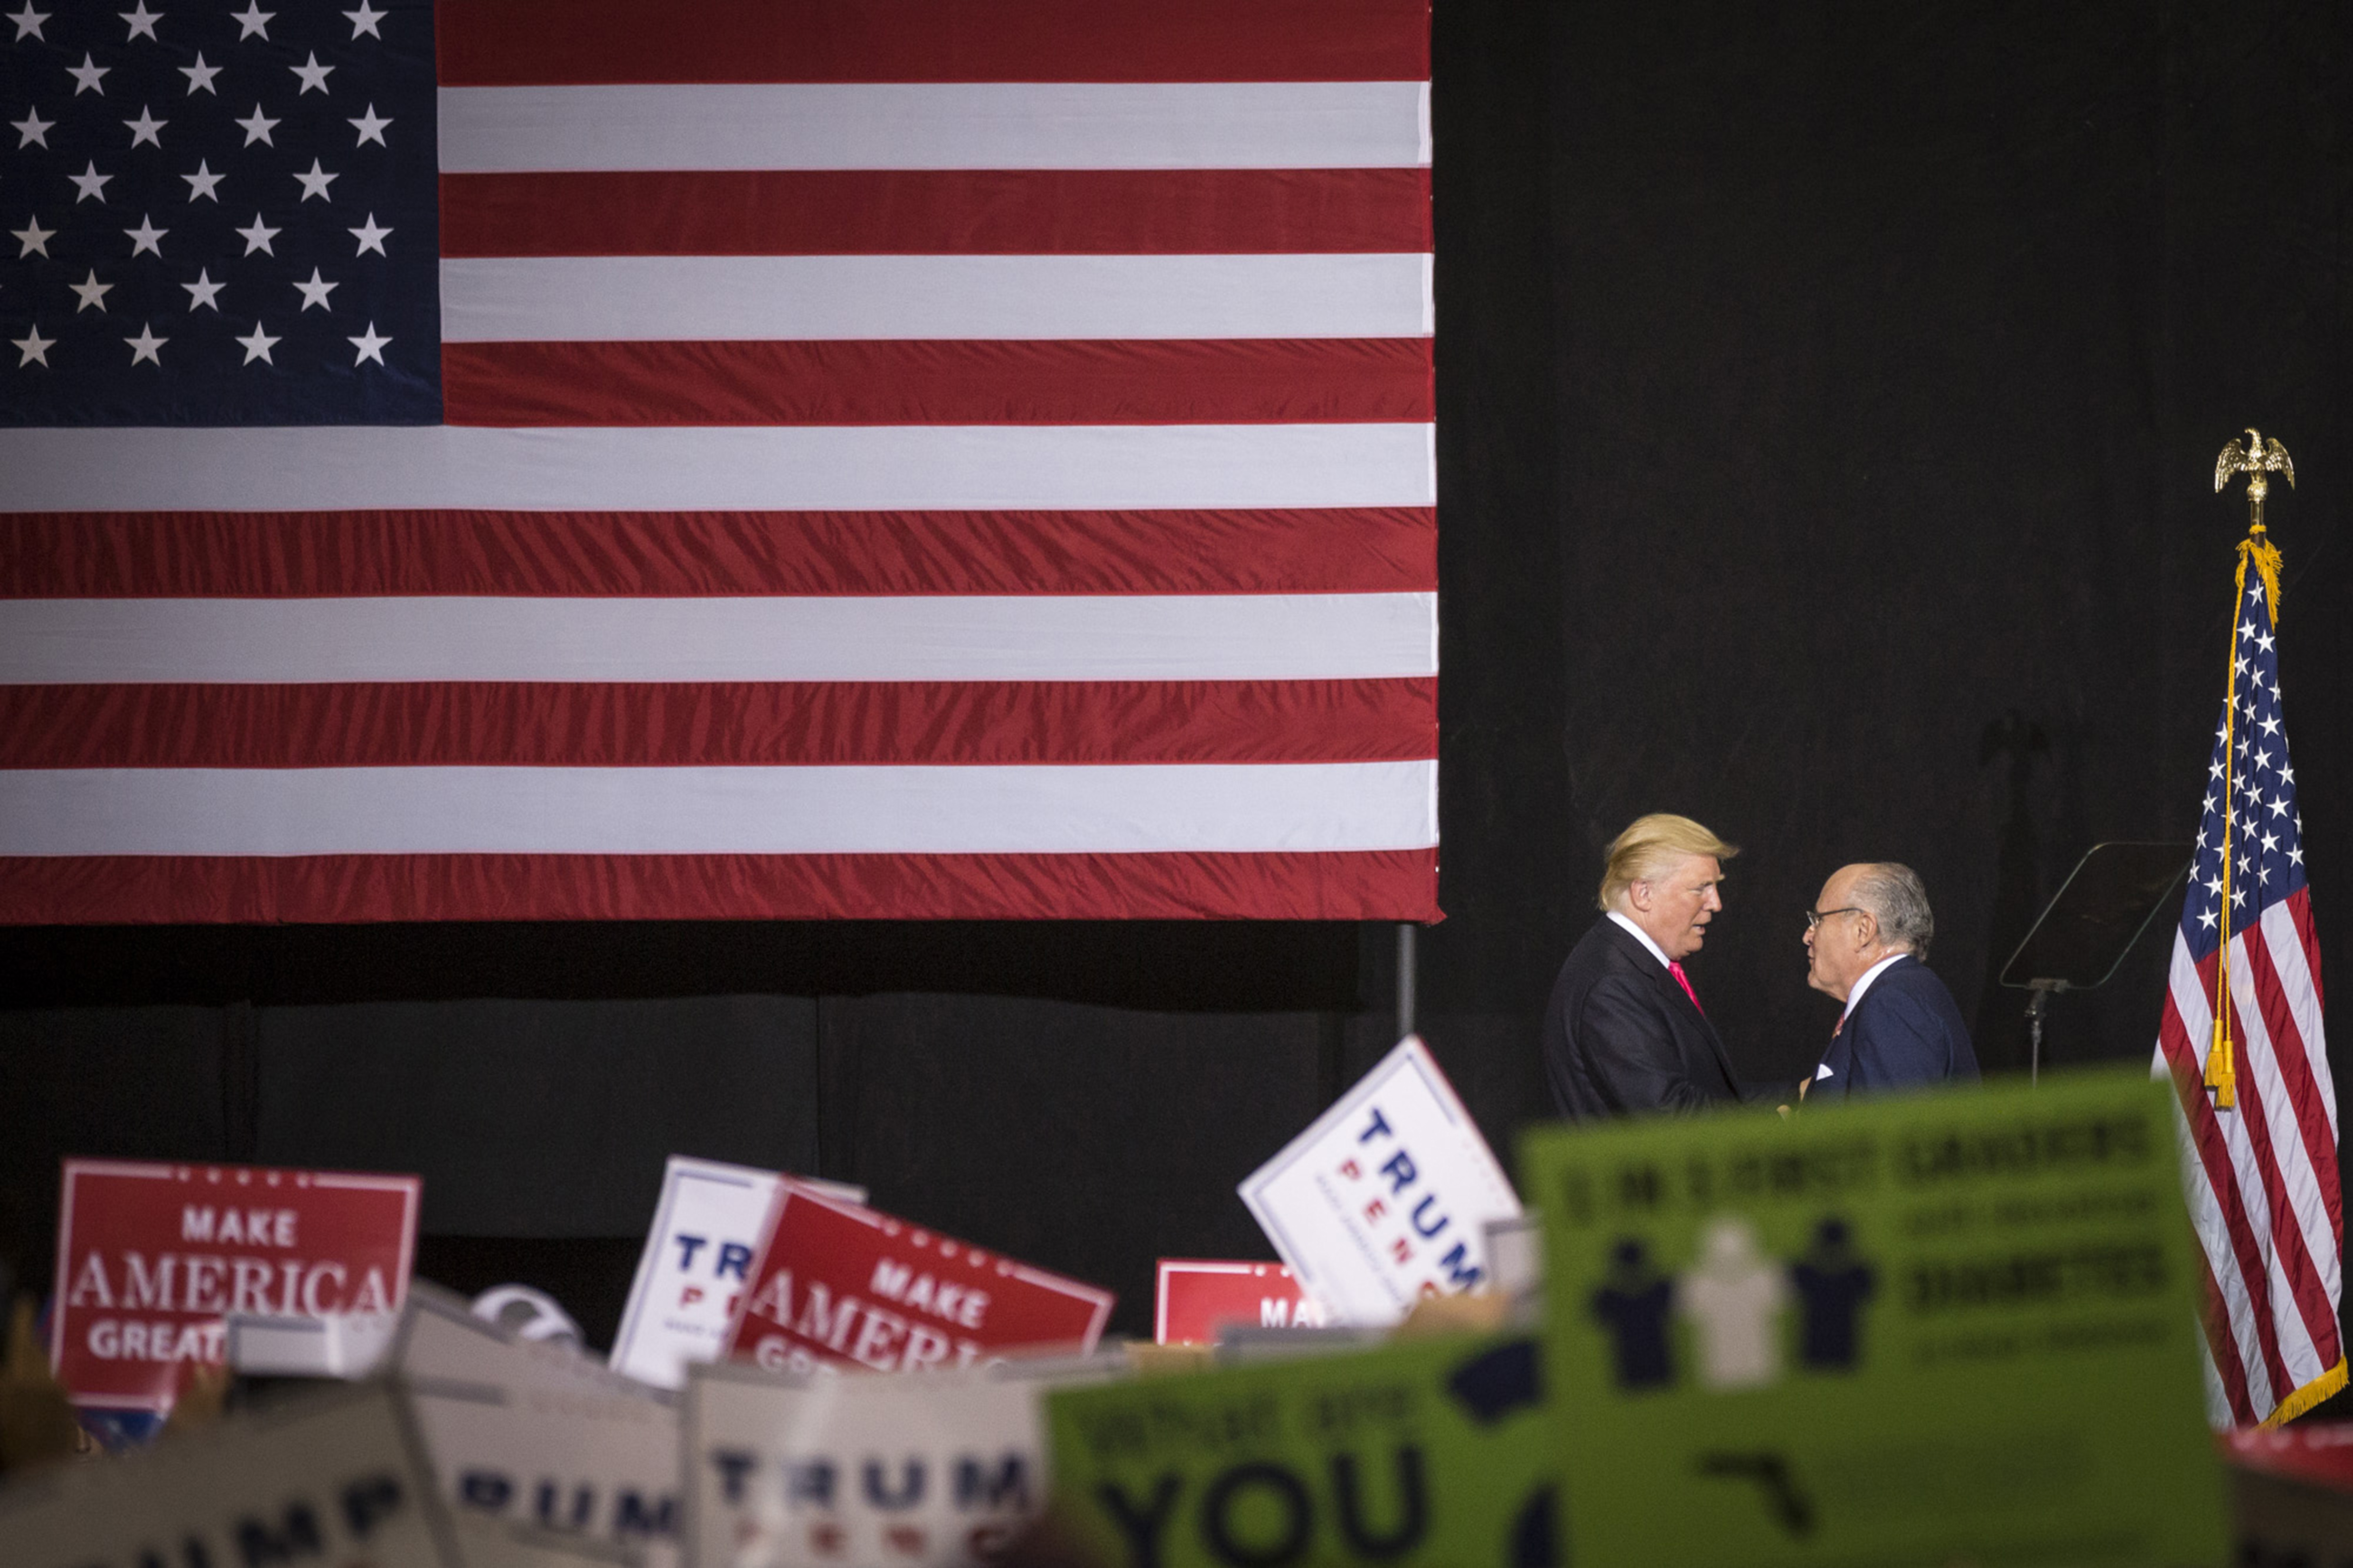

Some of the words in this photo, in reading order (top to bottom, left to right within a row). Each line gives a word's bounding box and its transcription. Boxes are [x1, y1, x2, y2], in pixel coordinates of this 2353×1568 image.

[182, 1205, 298, 1247] MAKE
[1337, 1157, 1442, 1298] PEN
[1357, 1107, 1484, 1293] TRUM
[70, 1251, 393, 1319] AMERICA
[870, 1257, 991, 1330] MAKE
[1260, 1296, 1321, 1329] MA
[88, 1320, 226, 1362] GREAT
[750, 1269, 1008, 1372] AMERI
[712, 1449, 1029, 1512] TRUM
[1099, 1442, 1427, 1568] YOU
